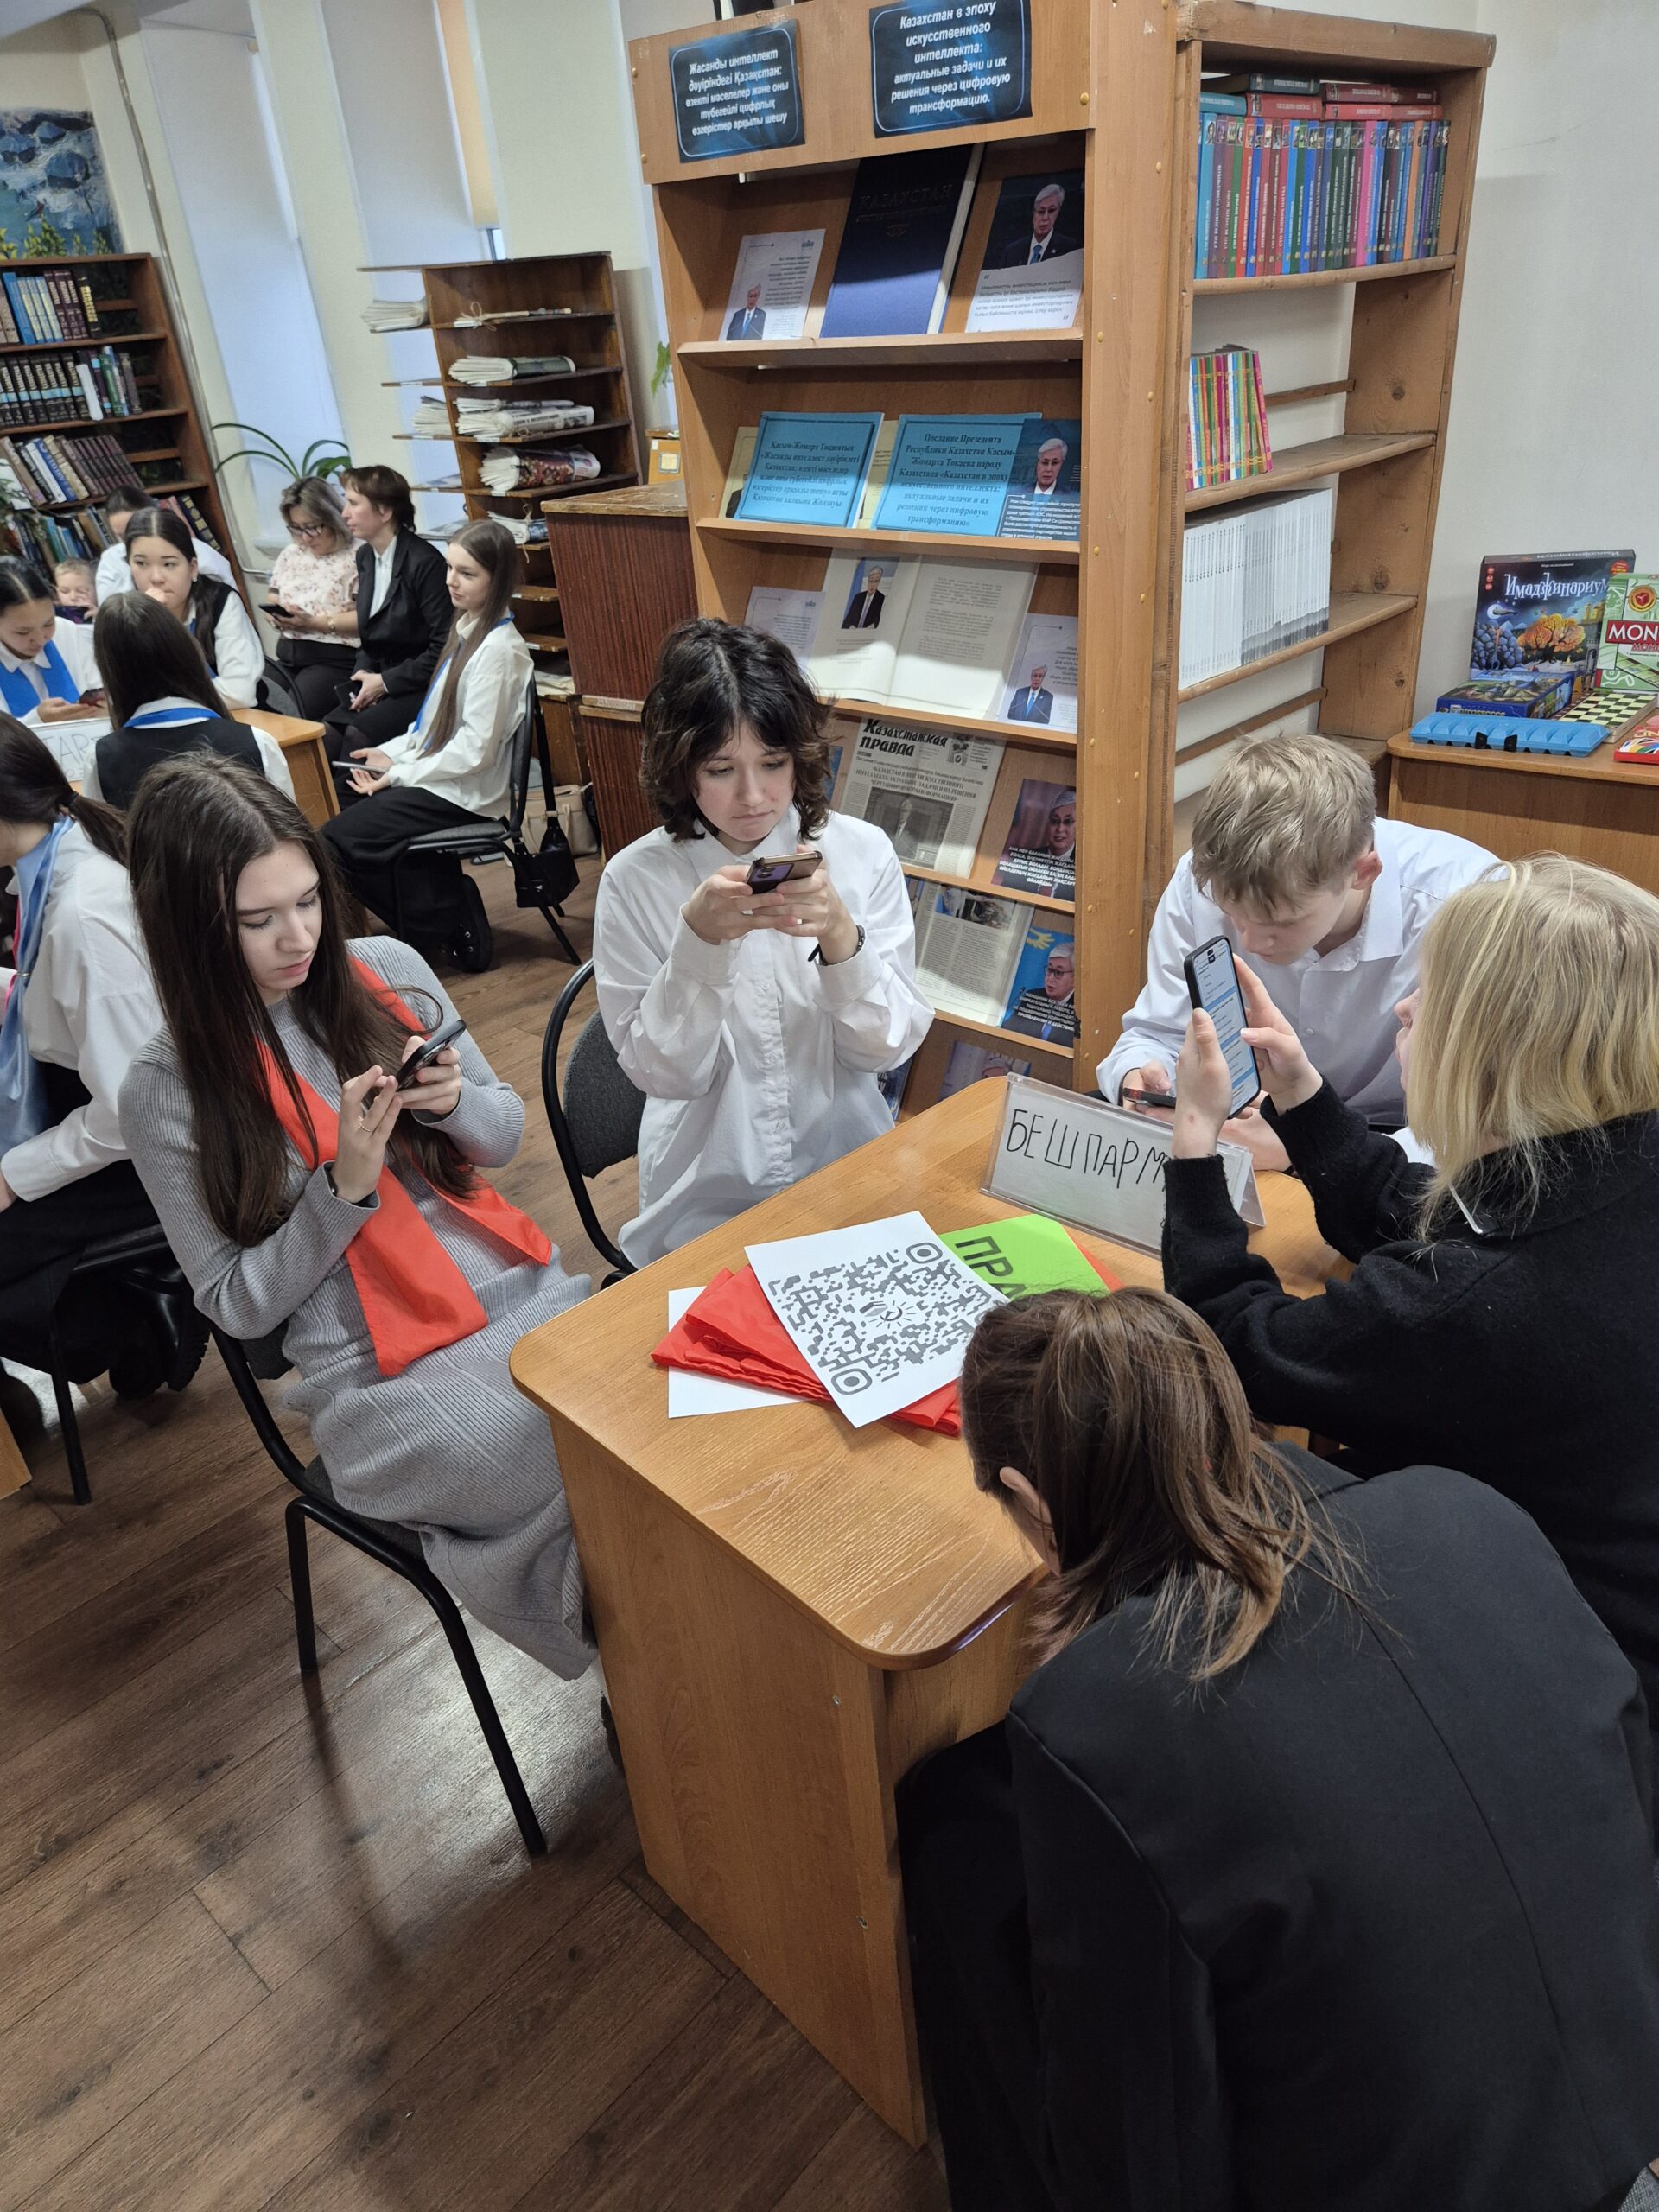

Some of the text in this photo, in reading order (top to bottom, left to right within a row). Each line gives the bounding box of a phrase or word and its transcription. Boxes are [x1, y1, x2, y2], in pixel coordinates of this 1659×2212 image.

[900, 1, 996, 29] Казахстан в эпоху
[906, 22, 990, 47] искусственного
[690, 50, 778, 75] Жасанды интеллект
[915, 43, 982, 64] интеллекта:
[894, 56, 1007, 84] актуальные задачи и их
[772, 82, 788, 92] оны
[892, 73, 1010, 104] решения через цифровую
[910, 94, 990, 115] трансформацию.
[765, 112, 787, 124] шешу
[924, 434, 959, 442] Послание
[906, 445, 947, 455] Республики
[949, 446, 985, 455] Казахстан
[899, 468, 938, 478] Казахстана
[912, 457, 1002, 471] Жомарта Токаева народу
[860, 736, 916, 757] правда
